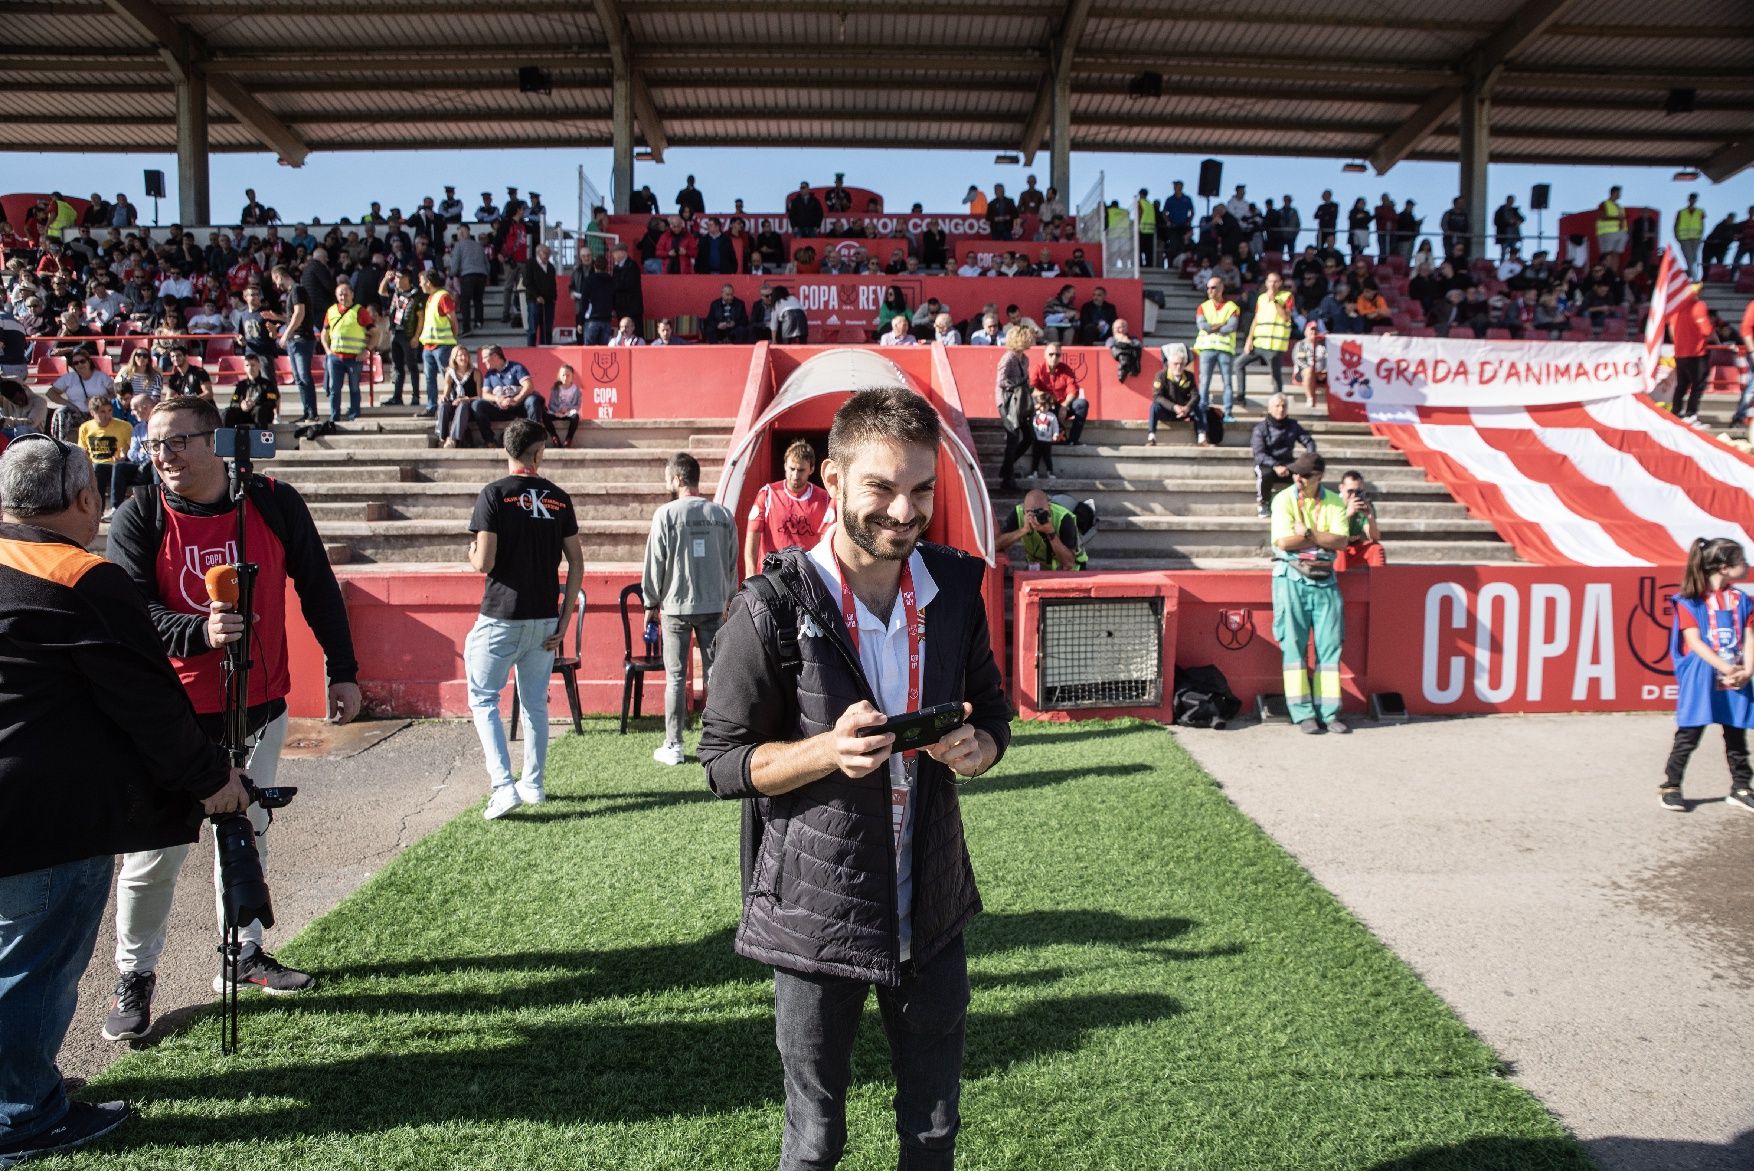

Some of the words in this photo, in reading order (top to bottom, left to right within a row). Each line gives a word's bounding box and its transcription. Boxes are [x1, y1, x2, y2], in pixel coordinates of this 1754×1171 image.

[800, 284, 838, 310] COPA
[859, 285, 886, 310] REY
[1375, 357, 1469, 386] GRADA
[594, 387, 617, 404] COPA
[598, 407, 613, 419] REY
[1422, 582, 1616, 704] COPA
